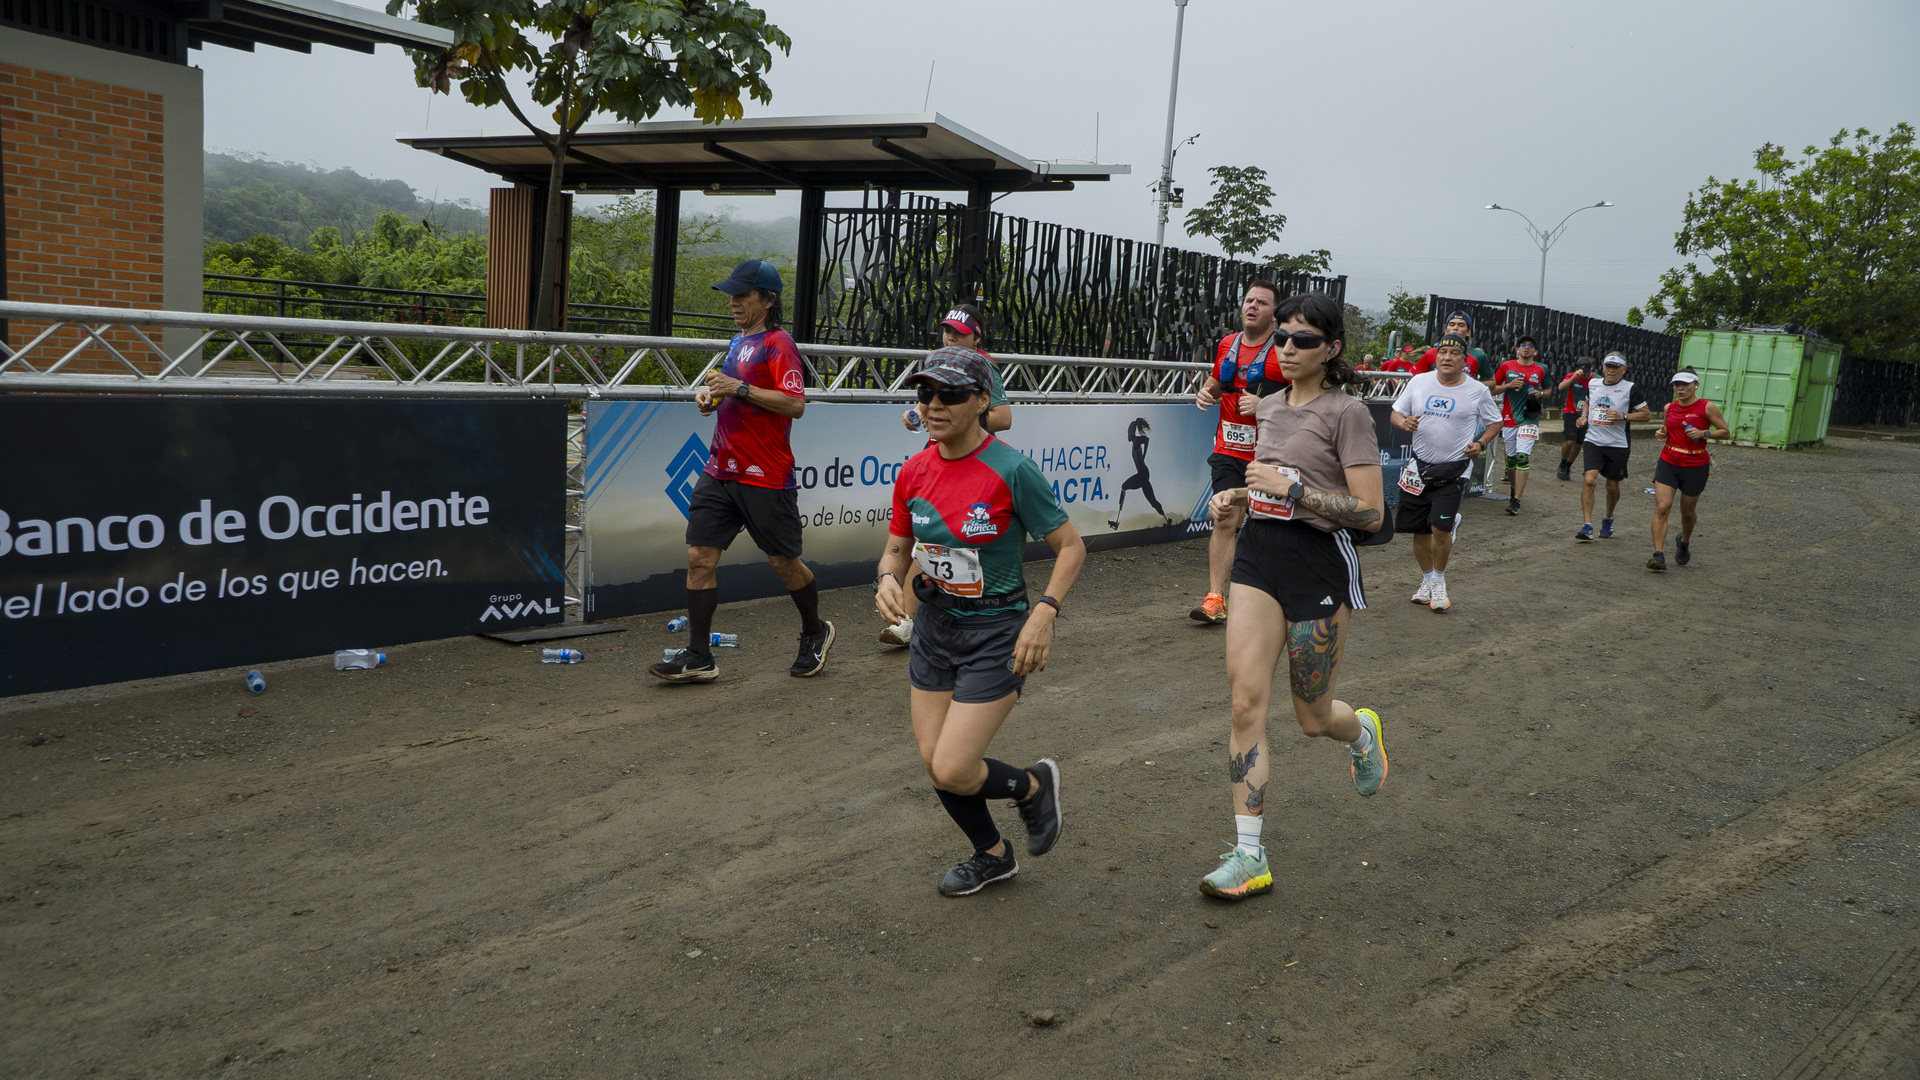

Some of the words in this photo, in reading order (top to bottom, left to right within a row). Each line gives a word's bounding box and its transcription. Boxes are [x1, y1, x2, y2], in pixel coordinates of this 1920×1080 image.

[946, 310, 970, 323] RUN
[1424, 410, 1450, 419] RUNNERS
[1226, 430, 1245, 442] 695
[1041, 445, 1111, 472] HACER,
[825, 457, 854, 488] de
[860, 455, 909, 486] Occ
[179, 499, 247, 546] de
[259, 490, 490, 540] Occidente
[813, 506, 834, 527] de
[838, 505, 862, 525] los
[866, 507, 893, 527] que
[928, 560, 954, 580] 73
[0, 583, 44, 619] el
[57, 578, 150, 614] lado
[159, 572, 207, 604] de
[218, 568, 268, 598] los
[278, 568, 340, 599] que
[349, 557, 449, 586] hacen.
[489, 593, 522, 604] Grupo
[479, 598, 560, 623] AVAL
